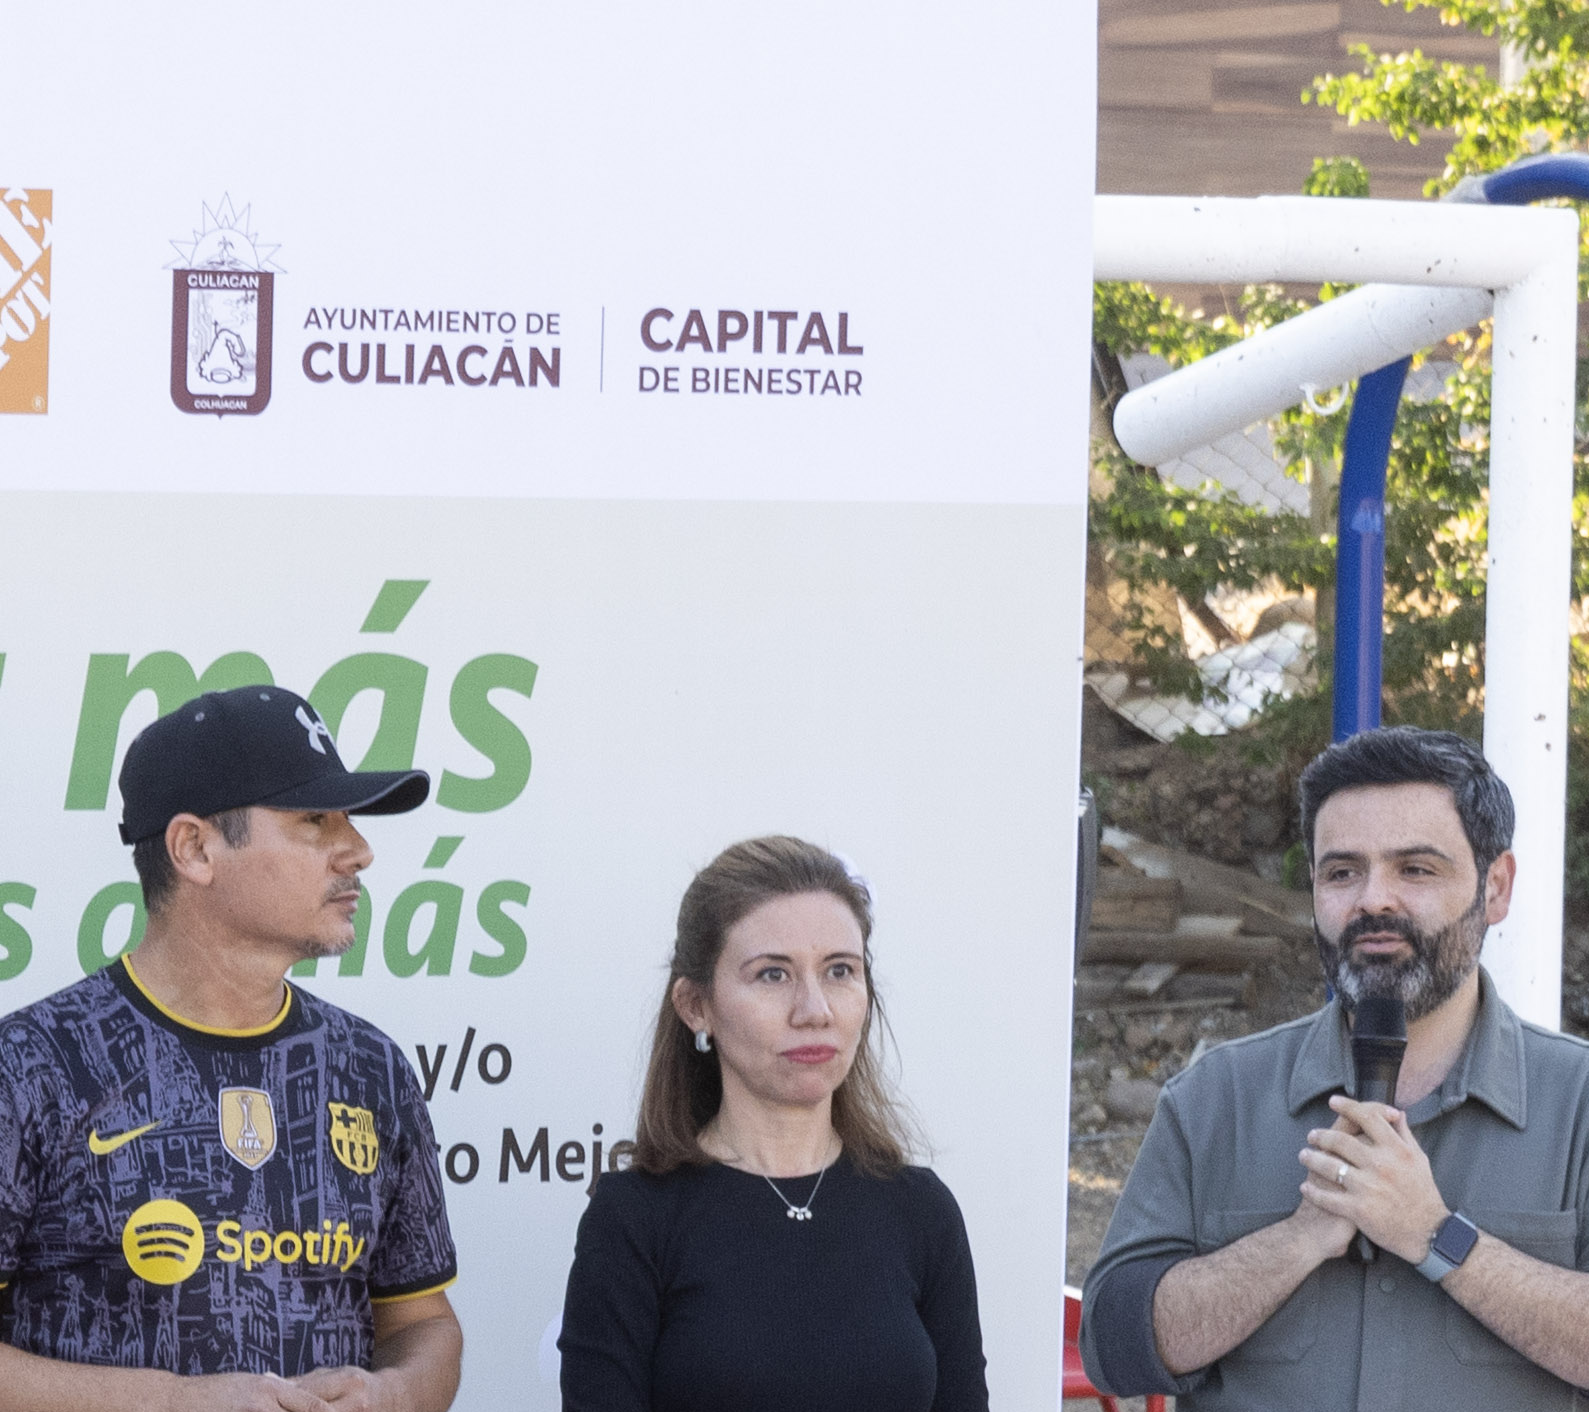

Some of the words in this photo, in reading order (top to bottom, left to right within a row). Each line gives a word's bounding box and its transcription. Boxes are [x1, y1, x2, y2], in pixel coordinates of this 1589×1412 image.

[187, 274, 260, 289] CULIACAN
[303, 307, 517, 335] AYUNTAMIENTO
[525, 312, 561, 336] DE
[639, 307, 865, 356] CAPITAL
[301, 339, 562, 388] CULIACÁN
[638, 366, 681, 394] DE
[690, 367, 864, 397] BIENESTAR
[416, 1026, 512, 1103] y/o
[216, 1219, 365, 1273] Spotify
